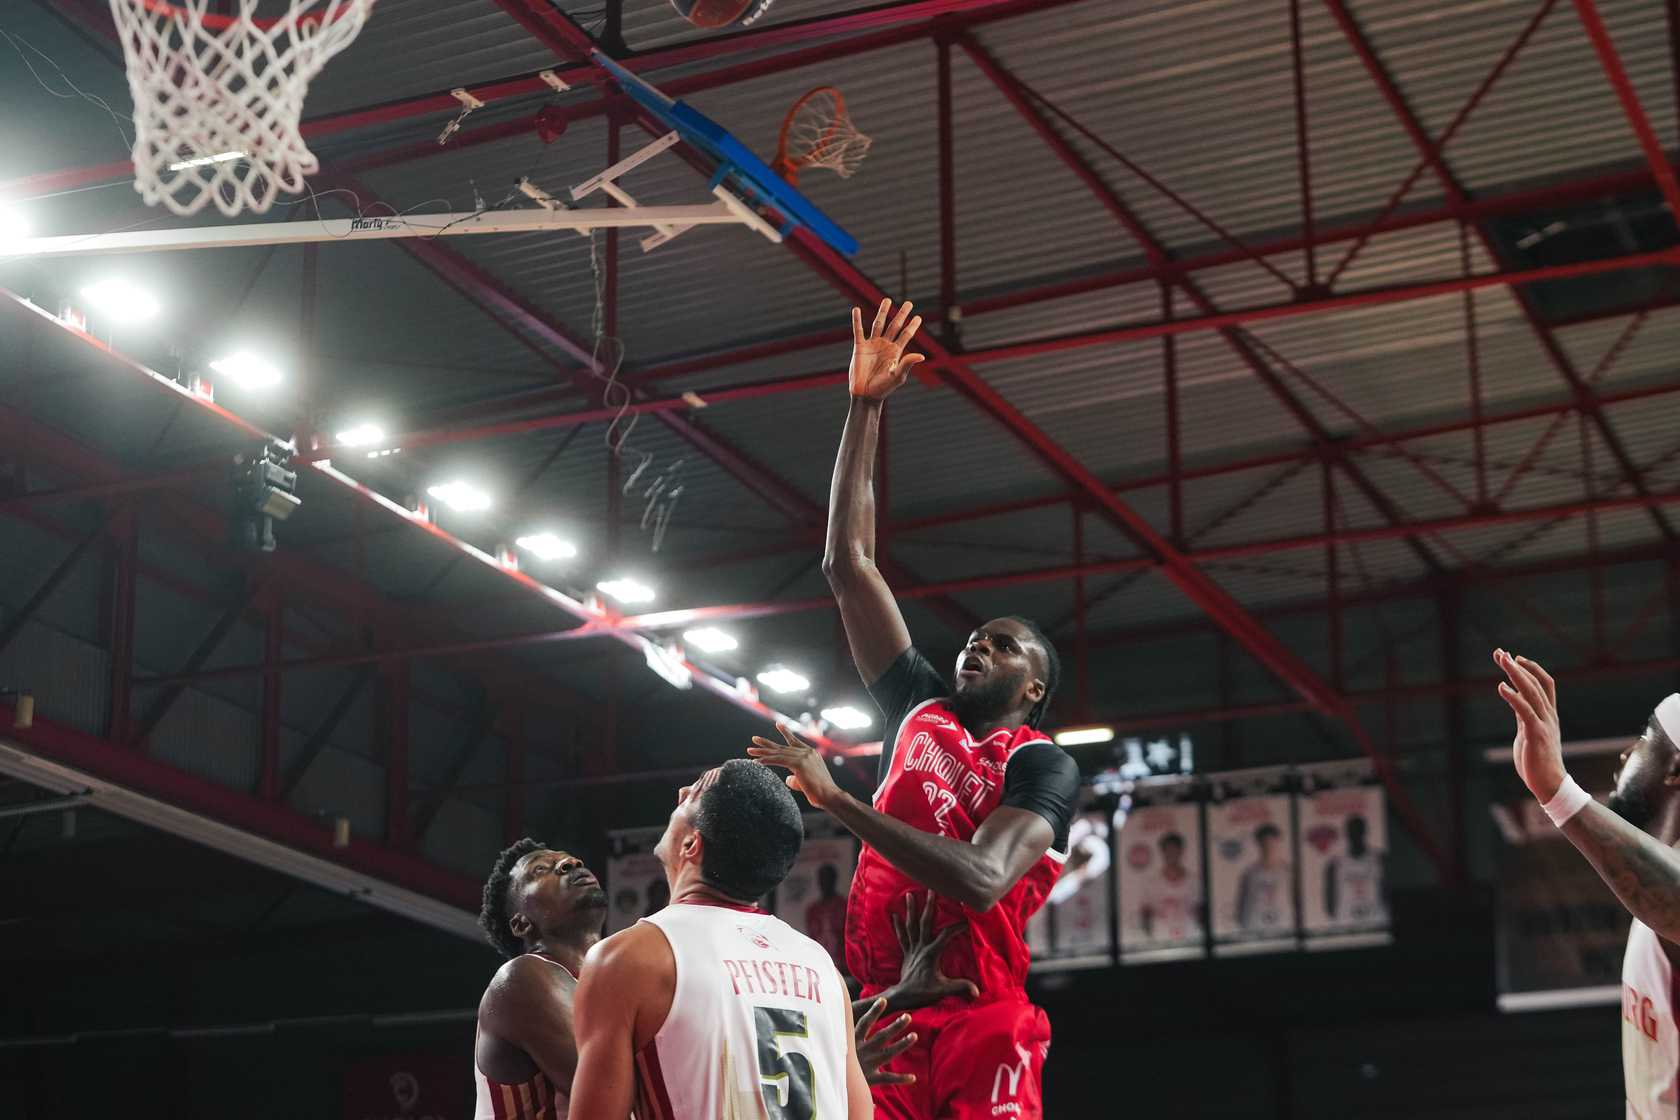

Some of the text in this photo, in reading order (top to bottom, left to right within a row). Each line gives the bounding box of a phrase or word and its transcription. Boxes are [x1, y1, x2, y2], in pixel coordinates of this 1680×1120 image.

[904, 731, 995, 811] CHOLET
[723, 959, 822, 1004] PFISTER
[753, 1006, 818, 1120] 5
